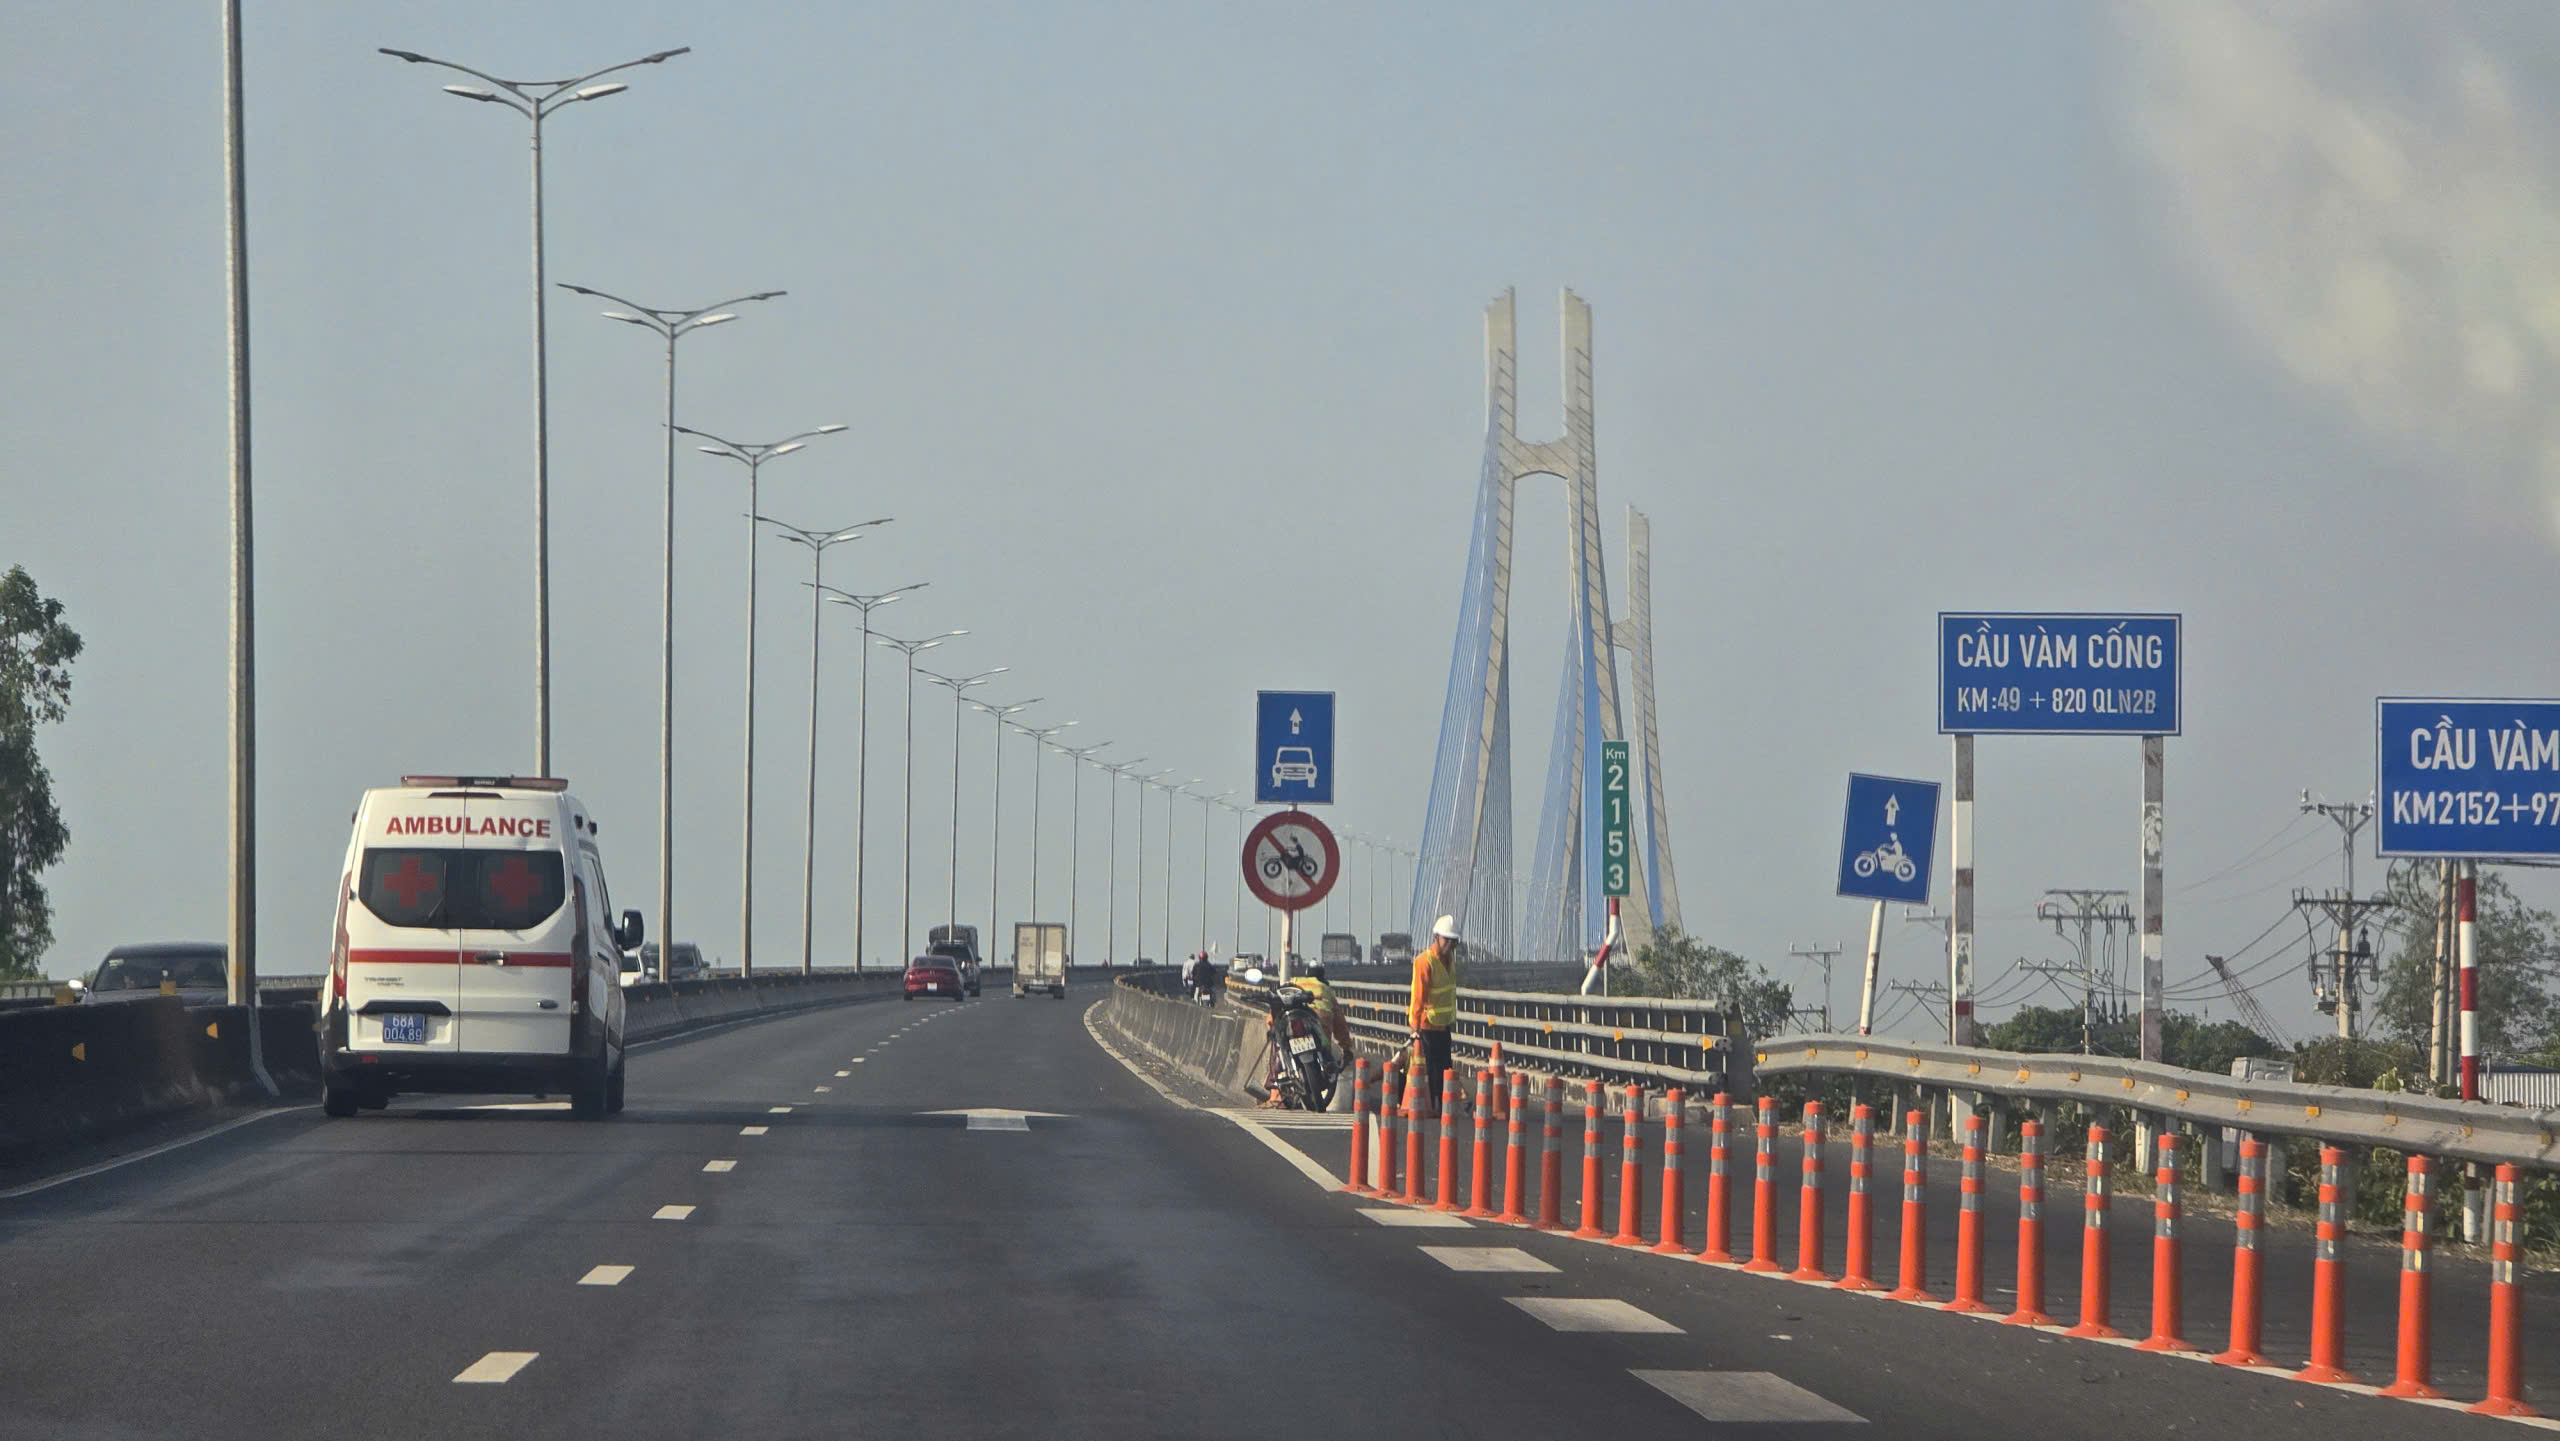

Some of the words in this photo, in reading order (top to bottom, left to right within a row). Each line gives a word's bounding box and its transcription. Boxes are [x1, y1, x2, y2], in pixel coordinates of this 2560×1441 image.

[1957, 620, 2009, 668] CẦU
[2019, 625, 2077, 668] VÀM
[2088, 621, 2162, 669] CỐNG
[2052, 688, 2086, 713] 820
[2092, 689, 2157, 715] QLN2B
[1606, 748, 1626, 760] Km
[2410, 714, 2476, 770] CẦU
[2488, 719, 2560, 771] VÀM
[386, 816, 551, 838] AMBULANCE
[392, 1015, 415, 1029] 68A
